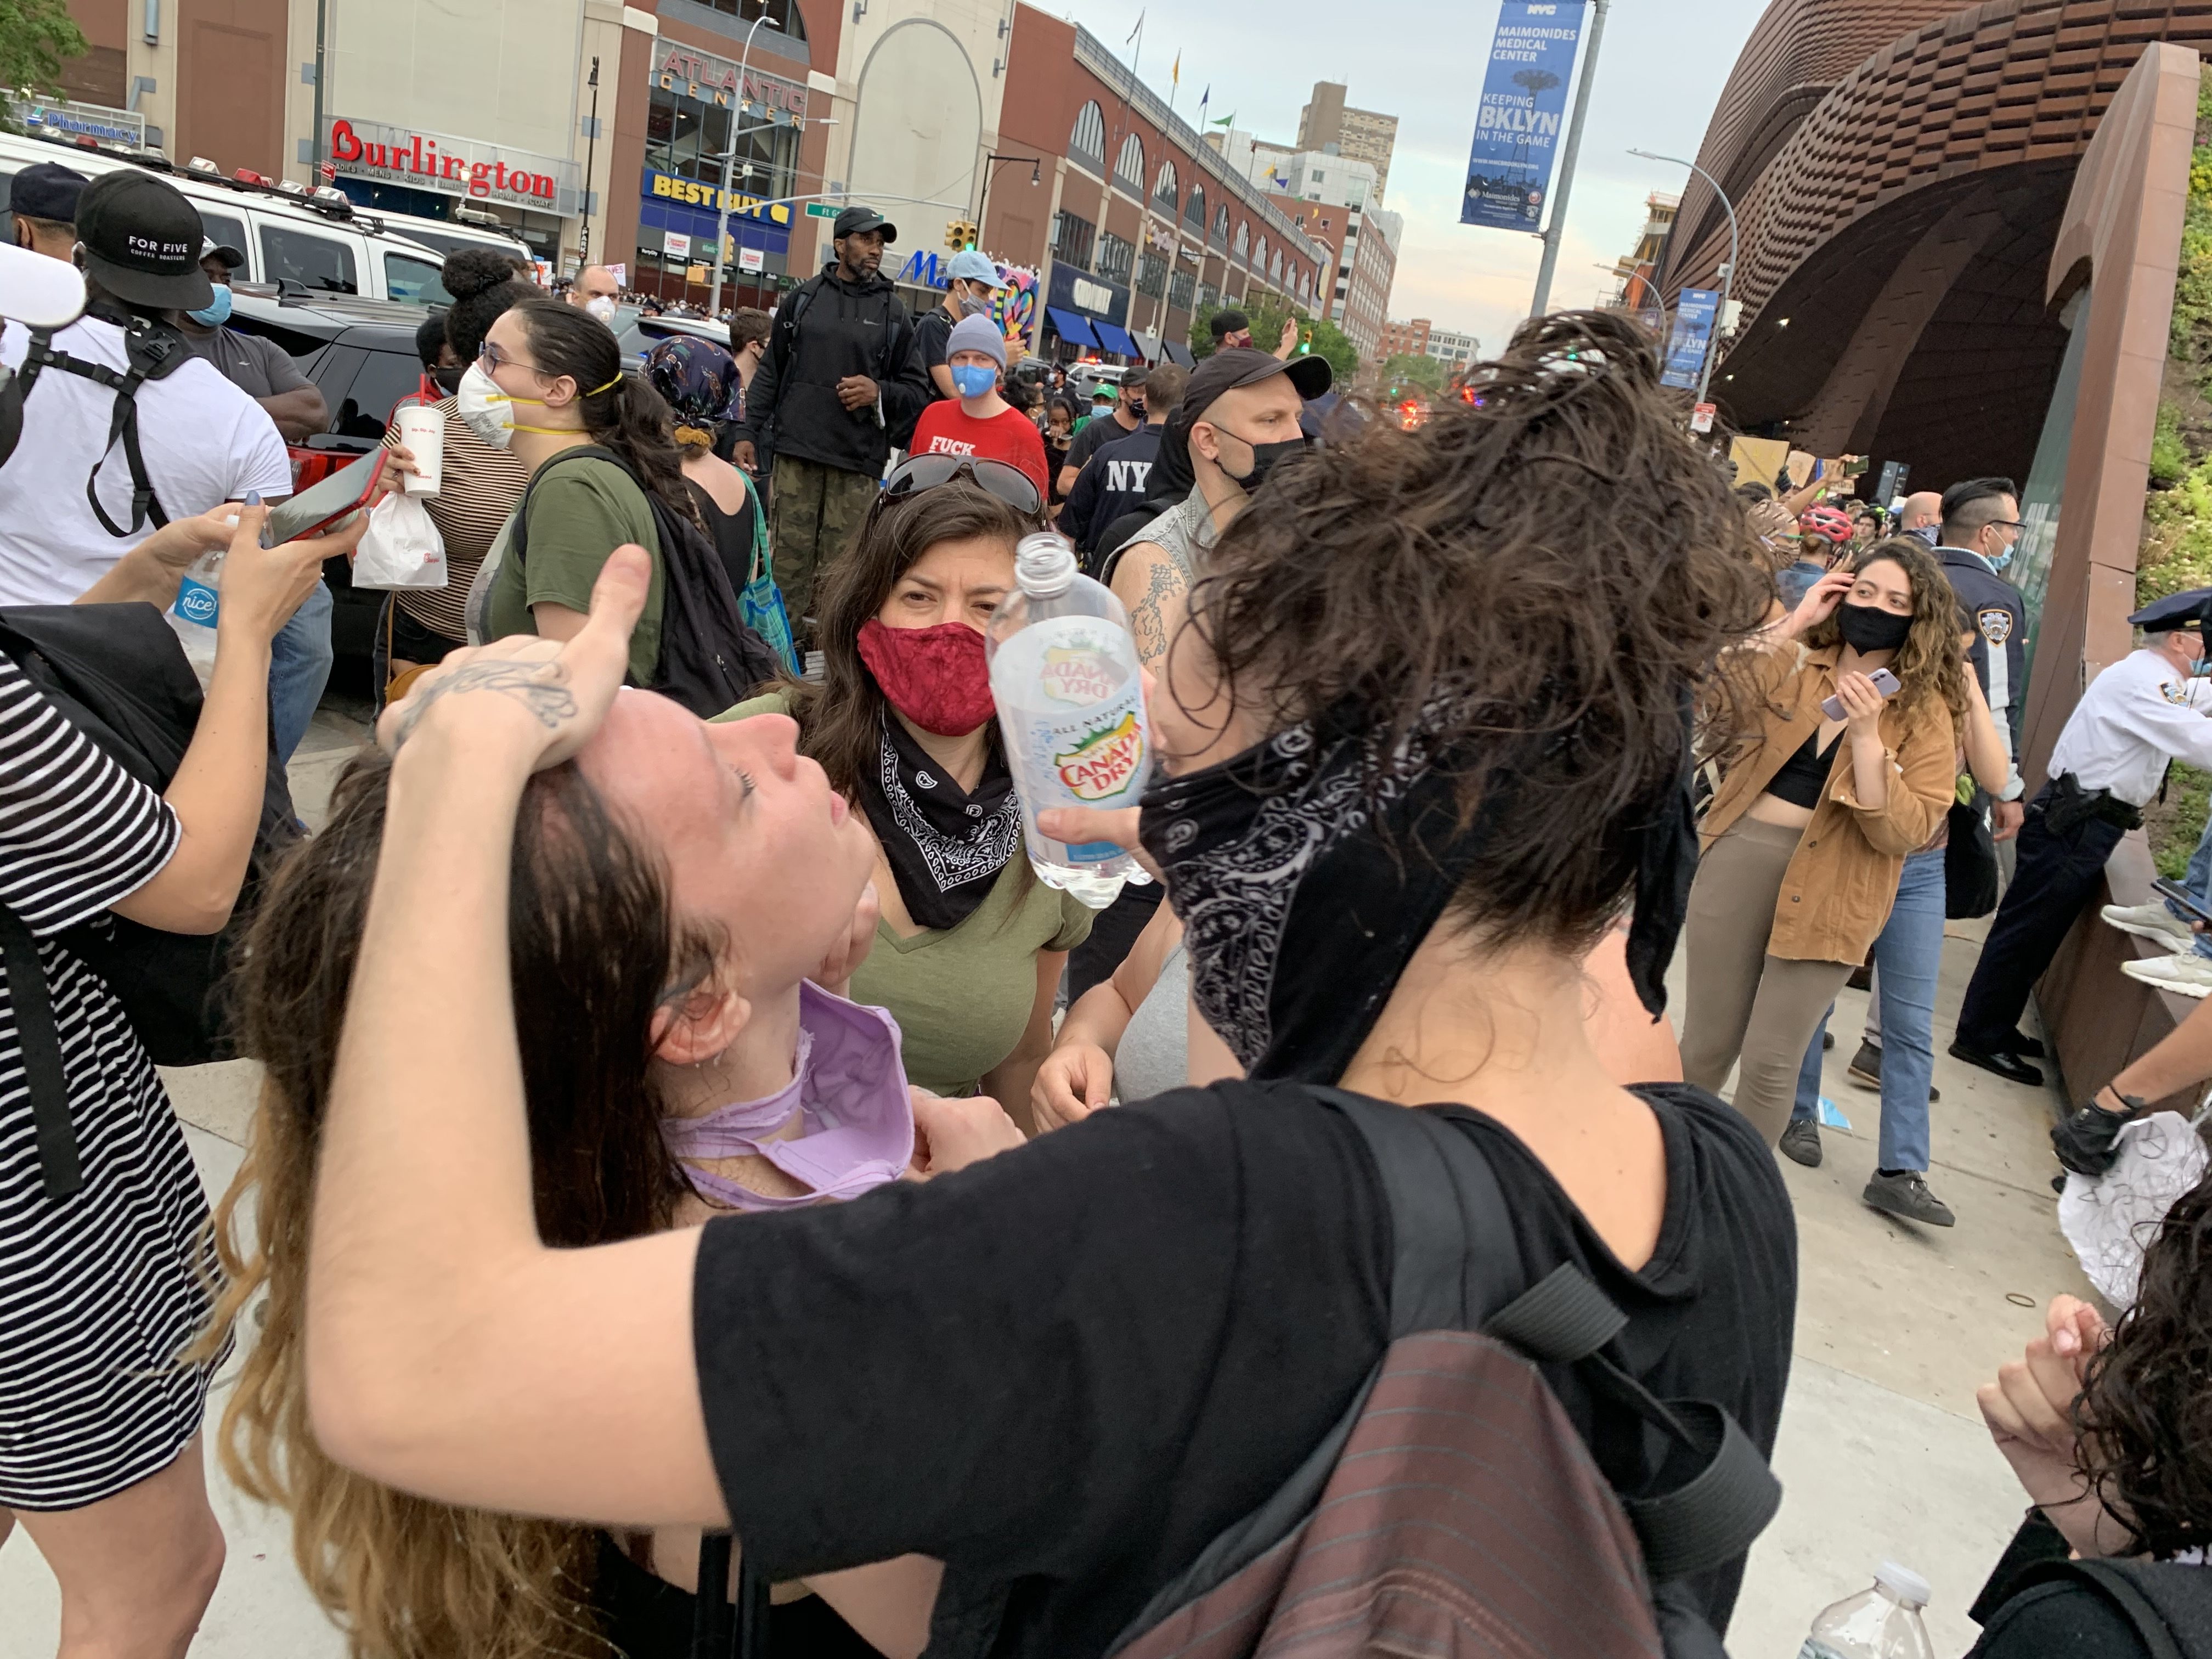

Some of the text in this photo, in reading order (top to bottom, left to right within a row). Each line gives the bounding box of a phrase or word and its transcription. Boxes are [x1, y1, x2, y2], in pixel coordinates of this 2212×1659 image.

[1527, 4, 1557, 15] NYC
[1495, 38, 1547, 50] MEDICAL
[1498, 26, 1577, 41] MAIMONIDES
[1493, 49, 1538, 62] CENTER
[659, 50, 806, 114] ATLANTIC
[1483, 93, 1534, 108] KEEPING
[48, 113, 138, 146] Pharmacy
[1479, 105, 1560, 136] BKLYN
[1476, 129, 1551, 148] IN THE GAME
[332, 120, 555, 199] Burlington
[335, 163, 357, 173] ADIES
[368, 168, 391, 179] MENS
[404, 174, 425, 185] KIDS
[492, 191, 518, 202] HOME
[528, 198, 554, 208] COATS
[653, 174, 767, 218] BEST BUY
[1482, 190, 1520, 202] Maimonides
[822, 207, 829, 216] Ft
[129, 235, 188, 253] FOR FIVE
[928, 435, 976, 456] FUCK
[1106, 460, 1153, 493] NY
[182, 596, 217, 611] nice!
[1052, 695, 1136, 735] ALL NATURAL
[1059, 723, 1142, 788] CANADA
[1092, 757, 1133, 791] DRY
